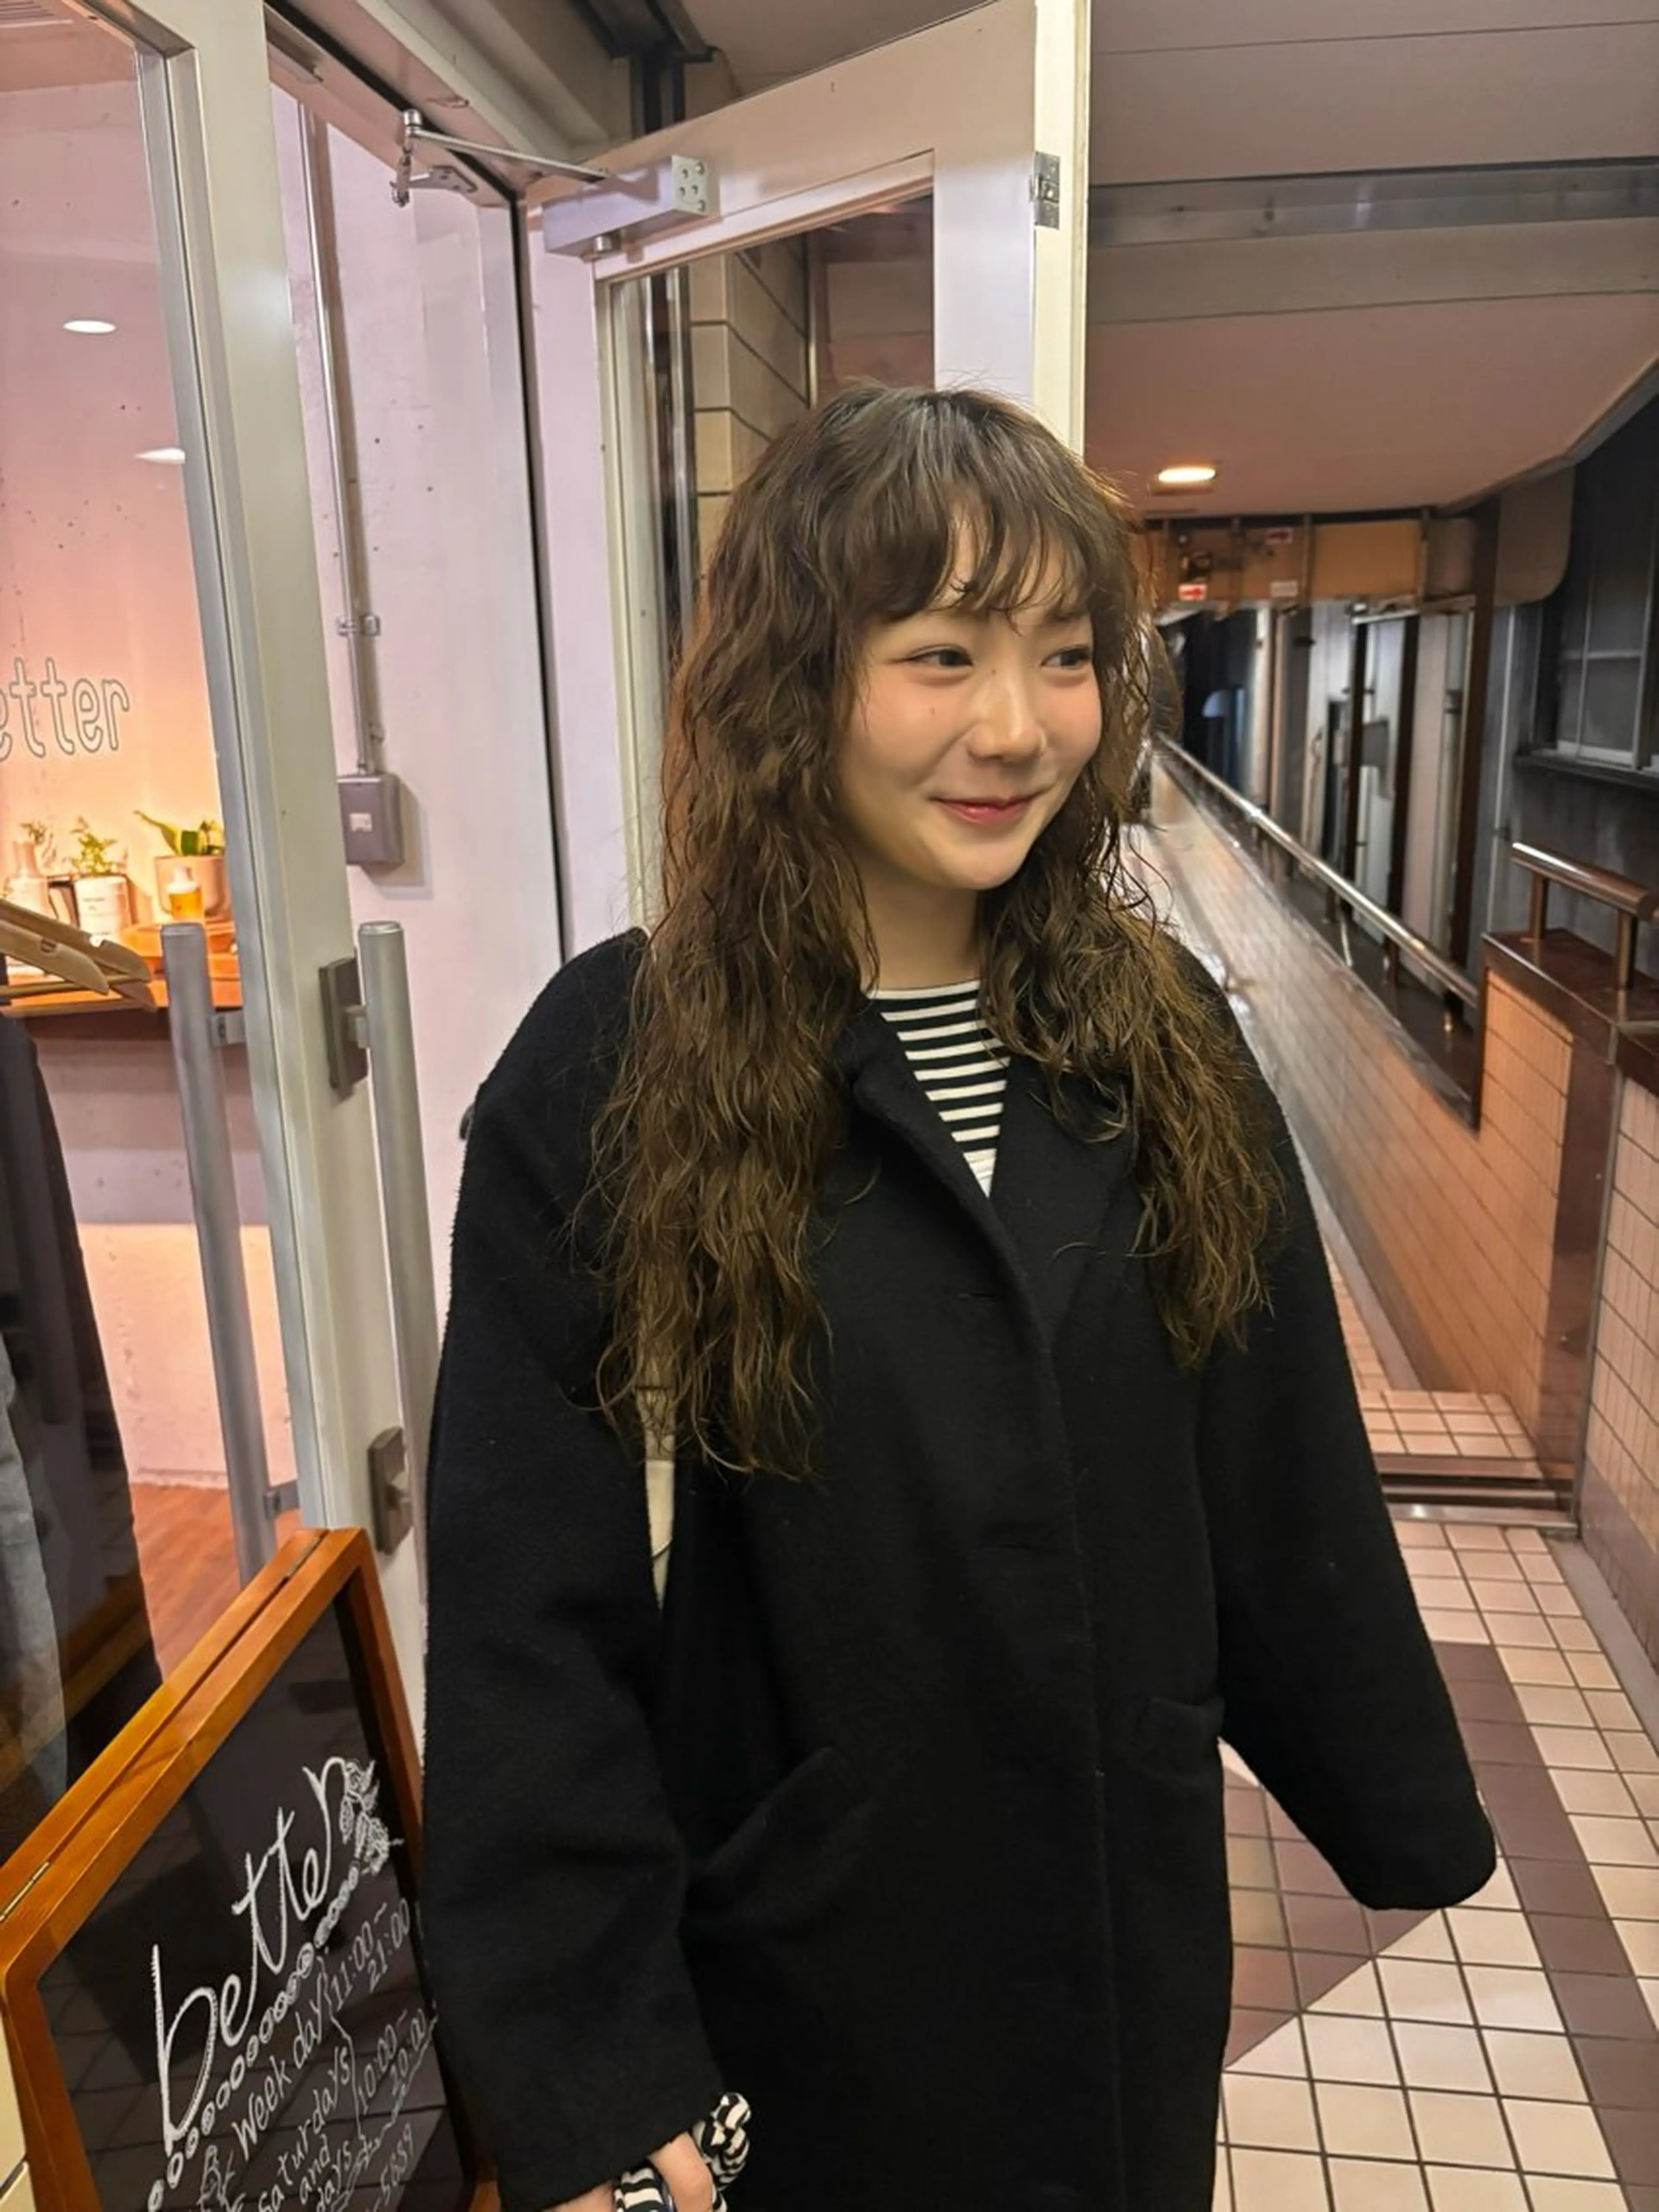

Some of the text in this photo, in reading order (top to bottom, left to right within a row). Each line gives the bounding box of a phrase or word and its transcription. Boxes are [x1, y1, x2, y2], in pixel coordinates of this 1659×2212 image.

[153, 1756, 348, 2156] better
[368, 1898, 410, 1994] 21:00
[299, 2133, 331, 2205] and
